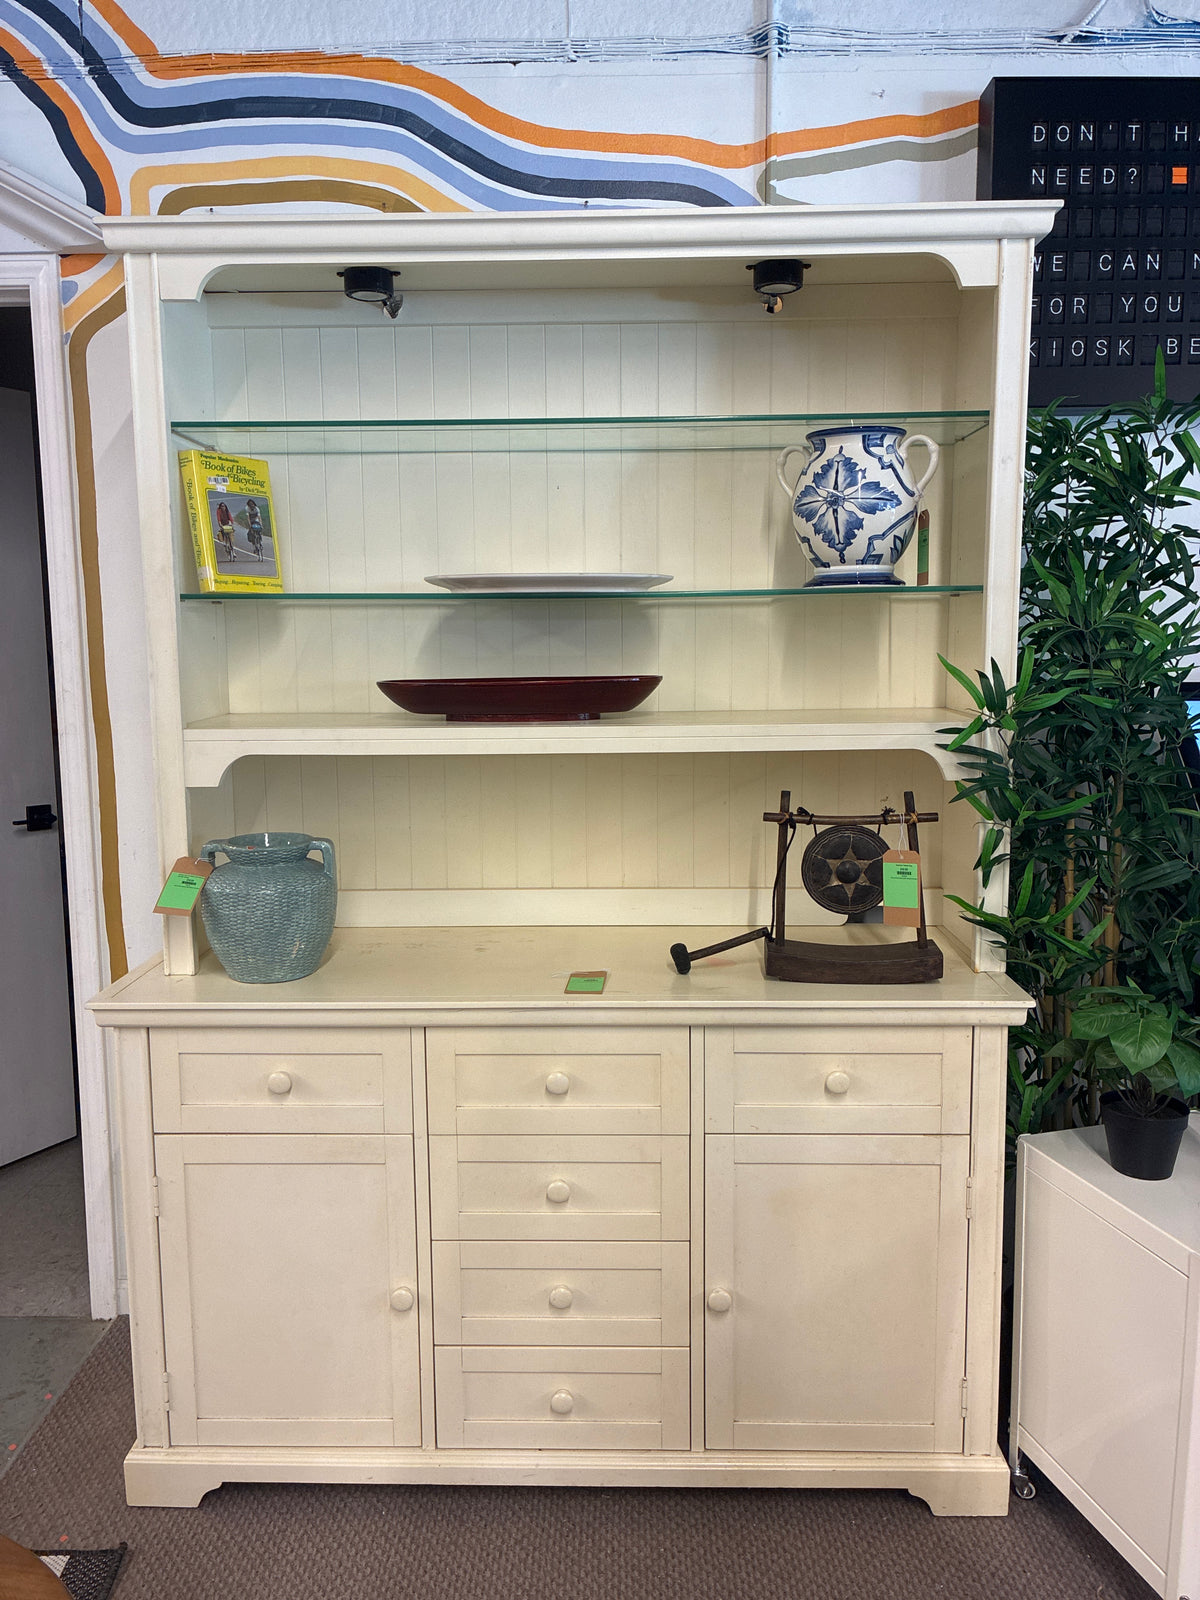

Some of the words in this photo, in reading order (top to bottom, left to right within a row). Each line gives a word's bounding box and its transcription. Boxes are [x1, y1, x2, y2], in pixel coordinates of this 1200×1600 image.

[1033, 124, 1141, 142] DON'T
[1174, 125, 1200, 142] H
[1032, 167, 1138, 185] NEED?
[1099, 253, 1160, 271] CAN
[1121, 295, 1181, 313] YOU
[1166, 338, 1200, 355] BE
[200, 459, 226, 472] Book
[226, 464, 236, 474] of
[236, 465, 257, 477] Bikes
[230, 473, 267, 488] Bicycling
